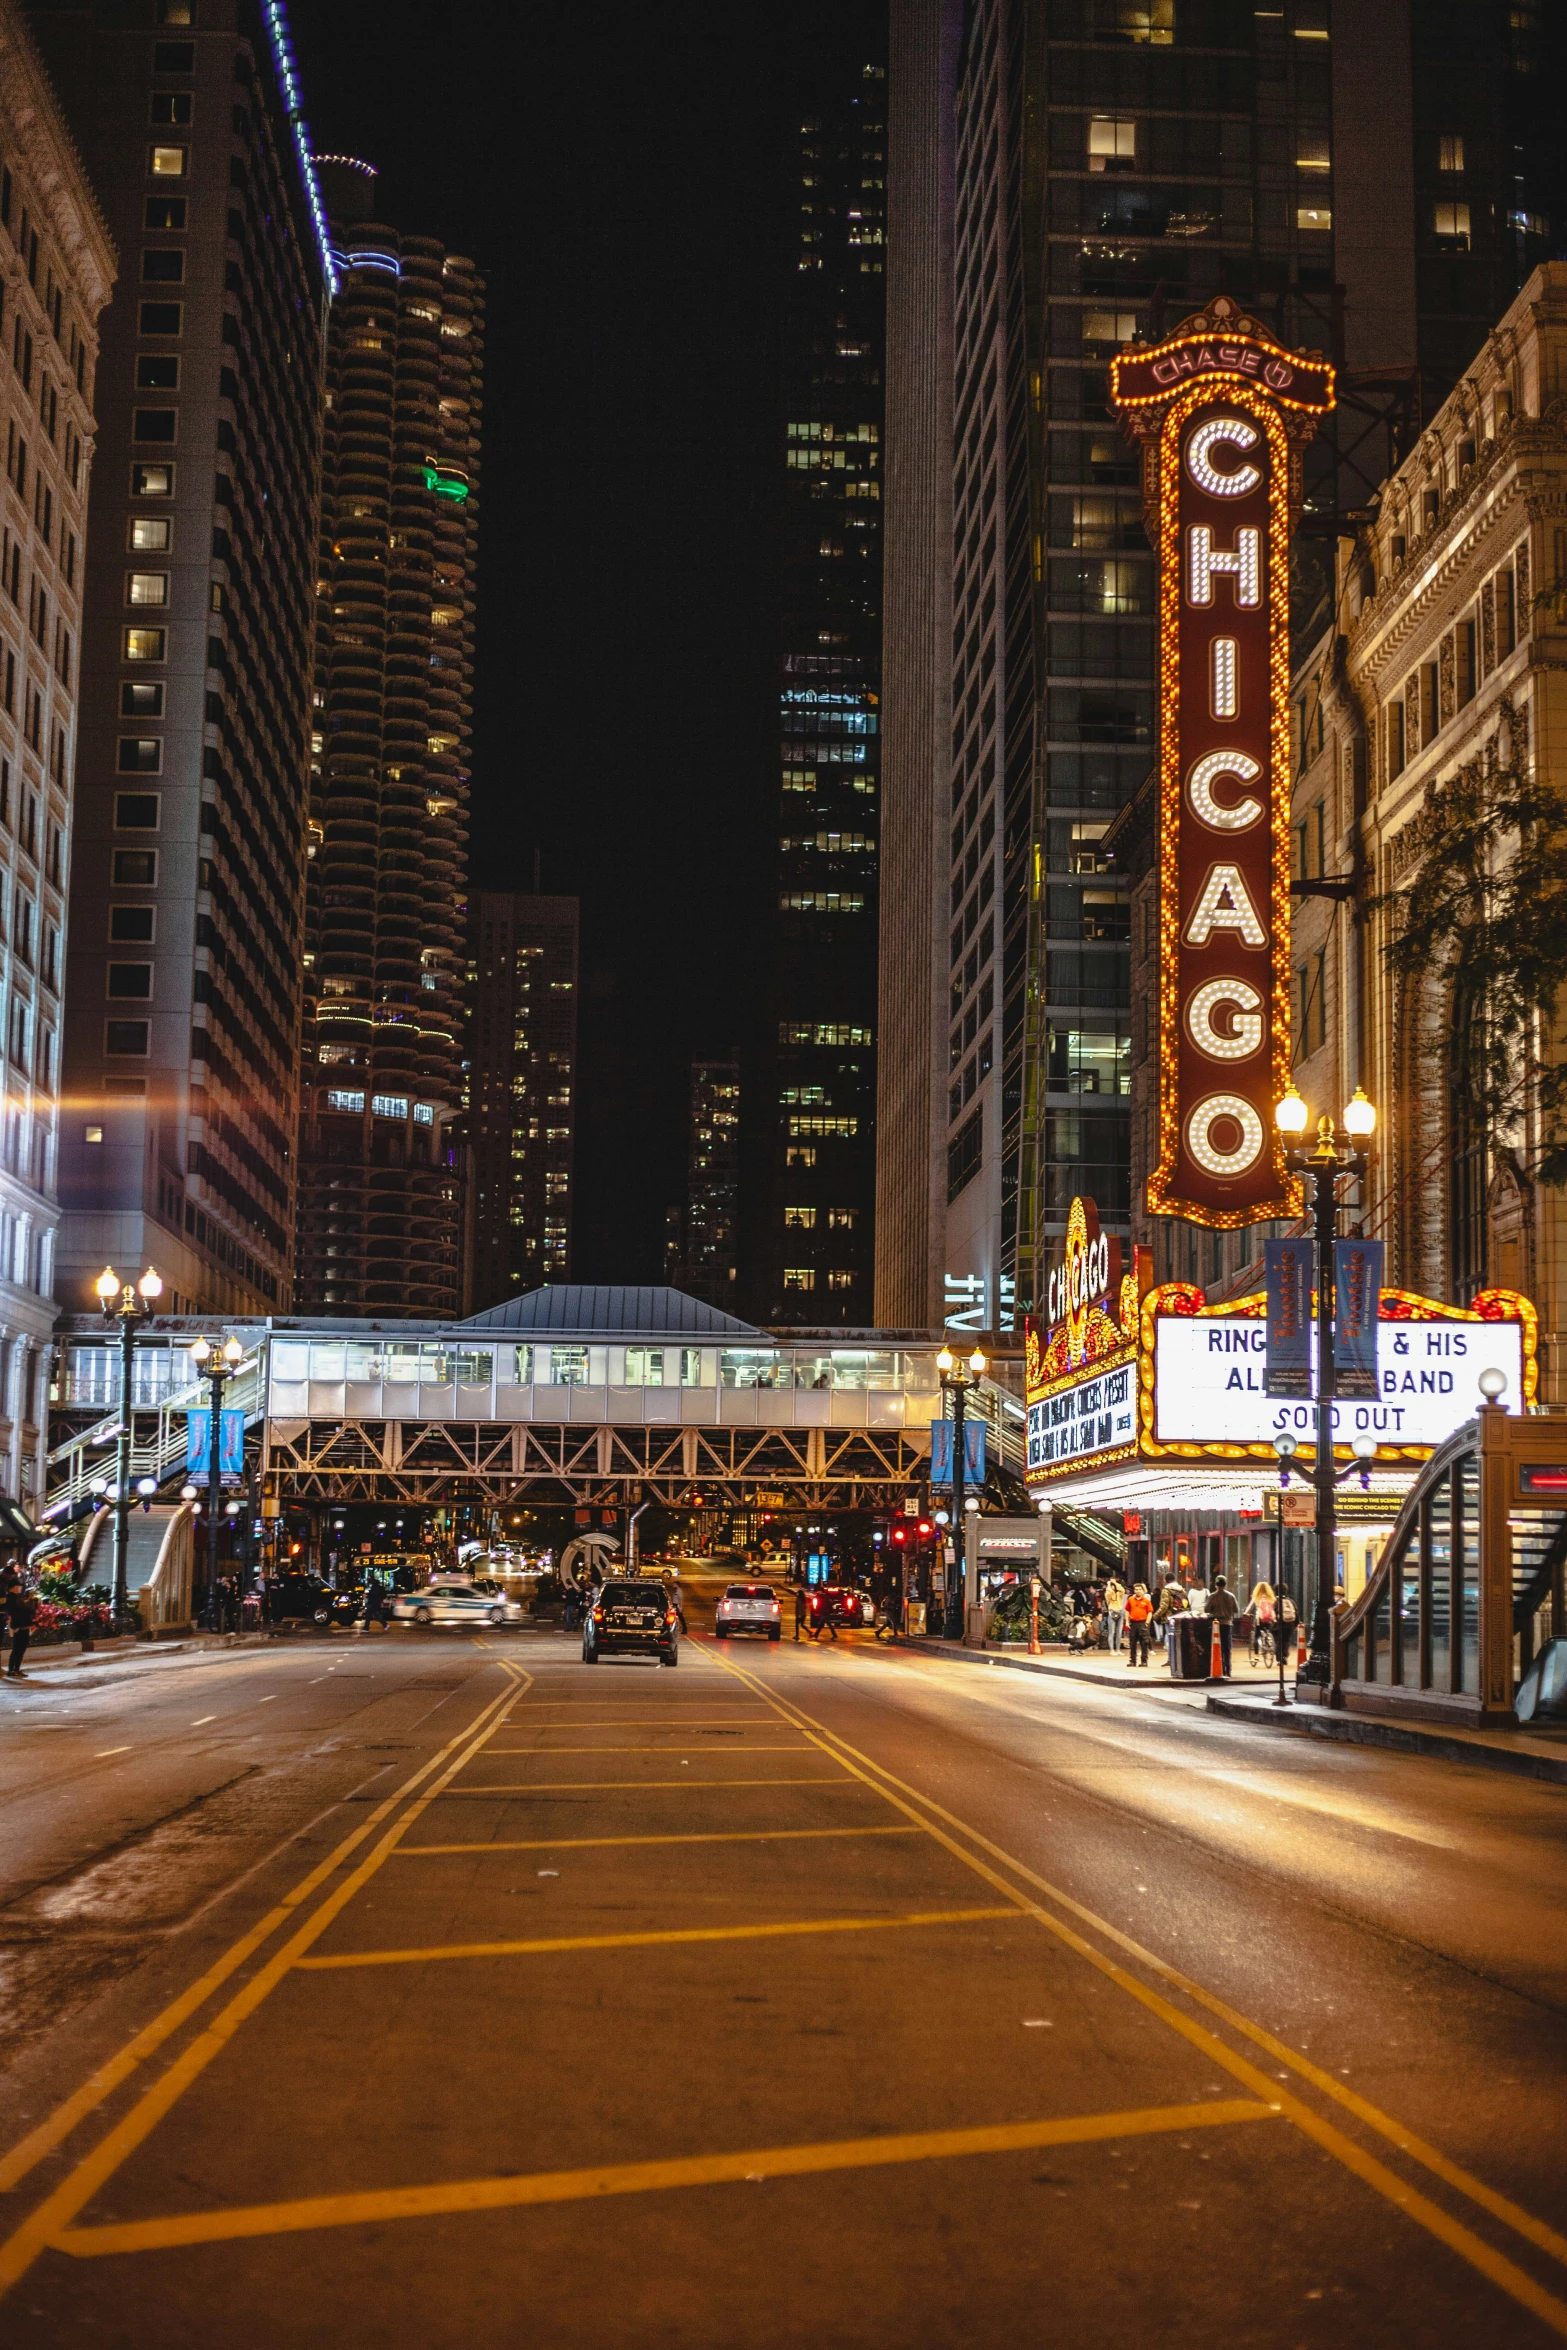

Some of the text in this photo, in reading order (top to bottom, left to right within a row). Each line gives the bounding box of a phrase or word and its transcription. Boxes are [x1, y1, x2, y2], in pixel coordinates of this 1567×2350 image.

[1152, 346, 1262, 384] CHASE
[1184, 418, 1267, 1177] CHICAGO
[1048, 1230, 1108, 1324] CHICAGO
[1208, 1329, 1467, 1355] RING & HIS
[1225, 1367, 1454, 1394] AL BAND
[1355, 1407, 1405, 1430] OUT
